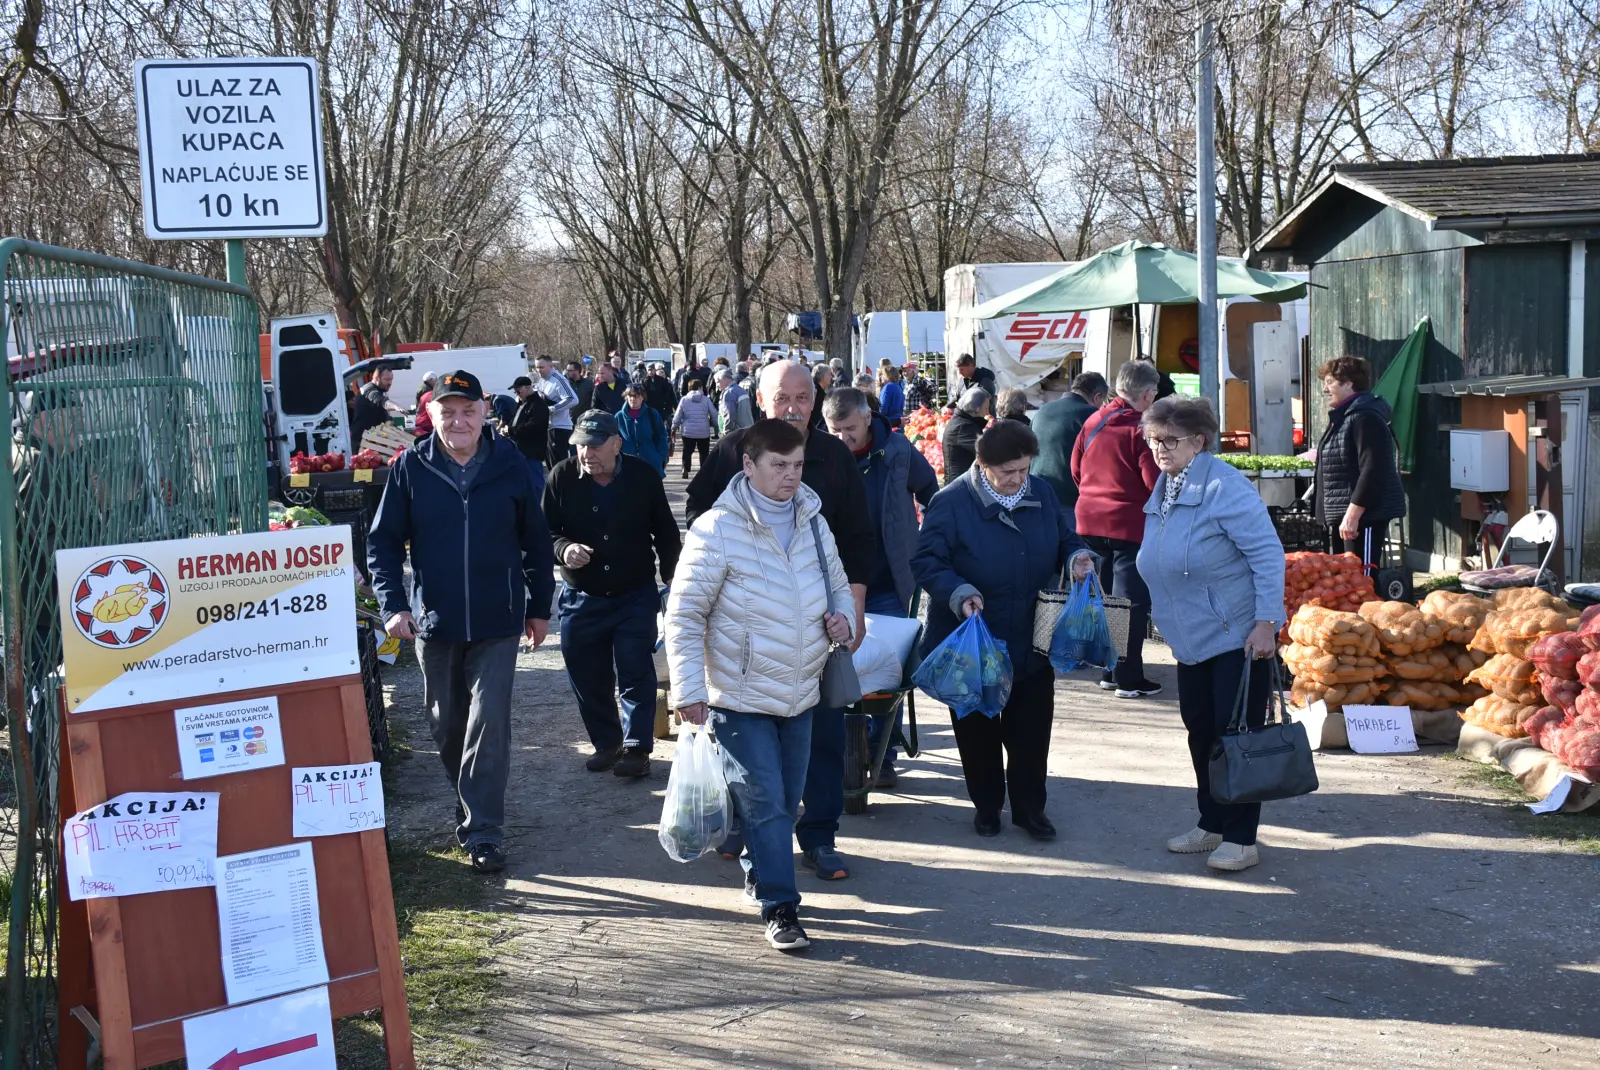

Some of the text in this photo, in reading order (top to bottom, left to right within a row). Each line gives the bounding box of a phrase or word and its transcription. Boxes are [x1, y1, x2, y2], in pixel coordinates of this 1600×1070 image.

[177, 78, 281, 97] ULAZ ZA
[186, 105, 276, 124] VOZILA
[182, 132, 284, 152] KUPACA
[162, 162, 309, 183] NAPLAĆUJE SE
[199, 193, 279, 217] 10 kn
[1005, 311, 1087, 340] Sch
[178, 543, 344, 580] HERMAN JOSIP
[179, 581, 214, 593] UZGOJ
[222, 576, 269, 589] PRODAJA
[196, 593, 328, 625] 098/241-828
[122, 636, 328, 673] www.peradarstvo-herman.hr
[226, 705, 269, 717] GOTOVINOM
[186, 723, 203, 731] SVIM
[205, 717, 241, 728] VRSTAMA
[242, 712, 274, 723] KARTICA
[1347, 717, 1401, 732] MARABEL
[301, 767, 373, 784] AKCIJA!
[79, 797, 206, 822] AKCIJA!
[114, 820, 178, 847] HRBAT
